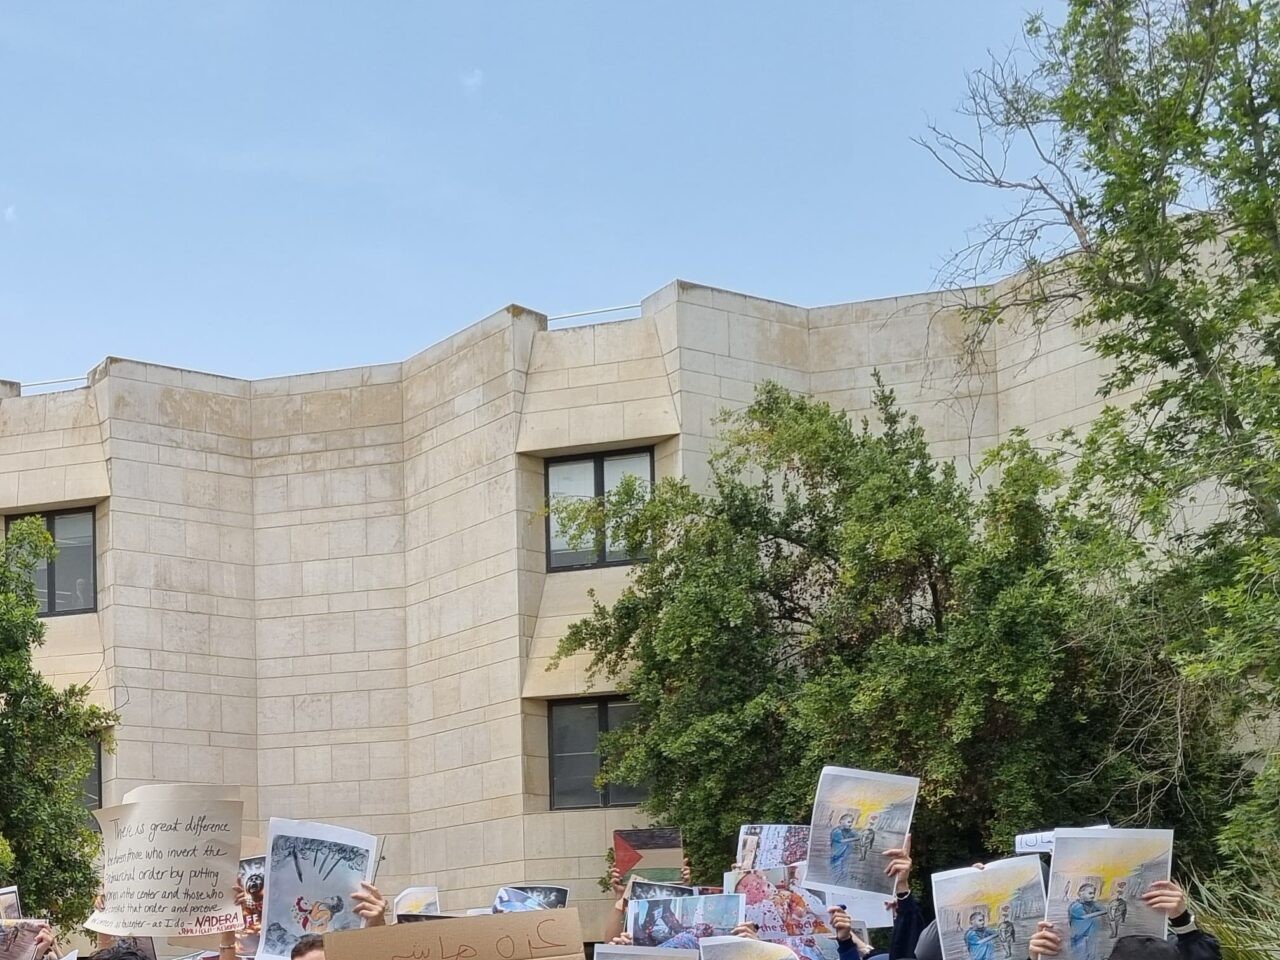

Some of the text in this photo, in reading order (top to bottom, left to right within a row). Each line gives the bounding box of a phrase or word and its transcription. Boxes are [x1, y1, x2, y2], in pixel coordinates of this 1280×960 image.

[148, 817, 182, 842] great
[185, 815, 231, 837] difference
[145, 847, 163, 860] who
[167, 845, 197, 859] invert
[203, 844, 228, 857] the
[138, 867, 169, 881] order
[169, 868, 184, 885] by
[189, 866, 220, 887] putting
[137, 889, 160, 900] center
[161, 888, 180, 900] and
[183, 887, 206, 901] those
[206, 888, 224, 900] who
[144, 903, 169, 914] order
[171, 903, 188, 914] and
[194, 912, 239, 929] NADERA
